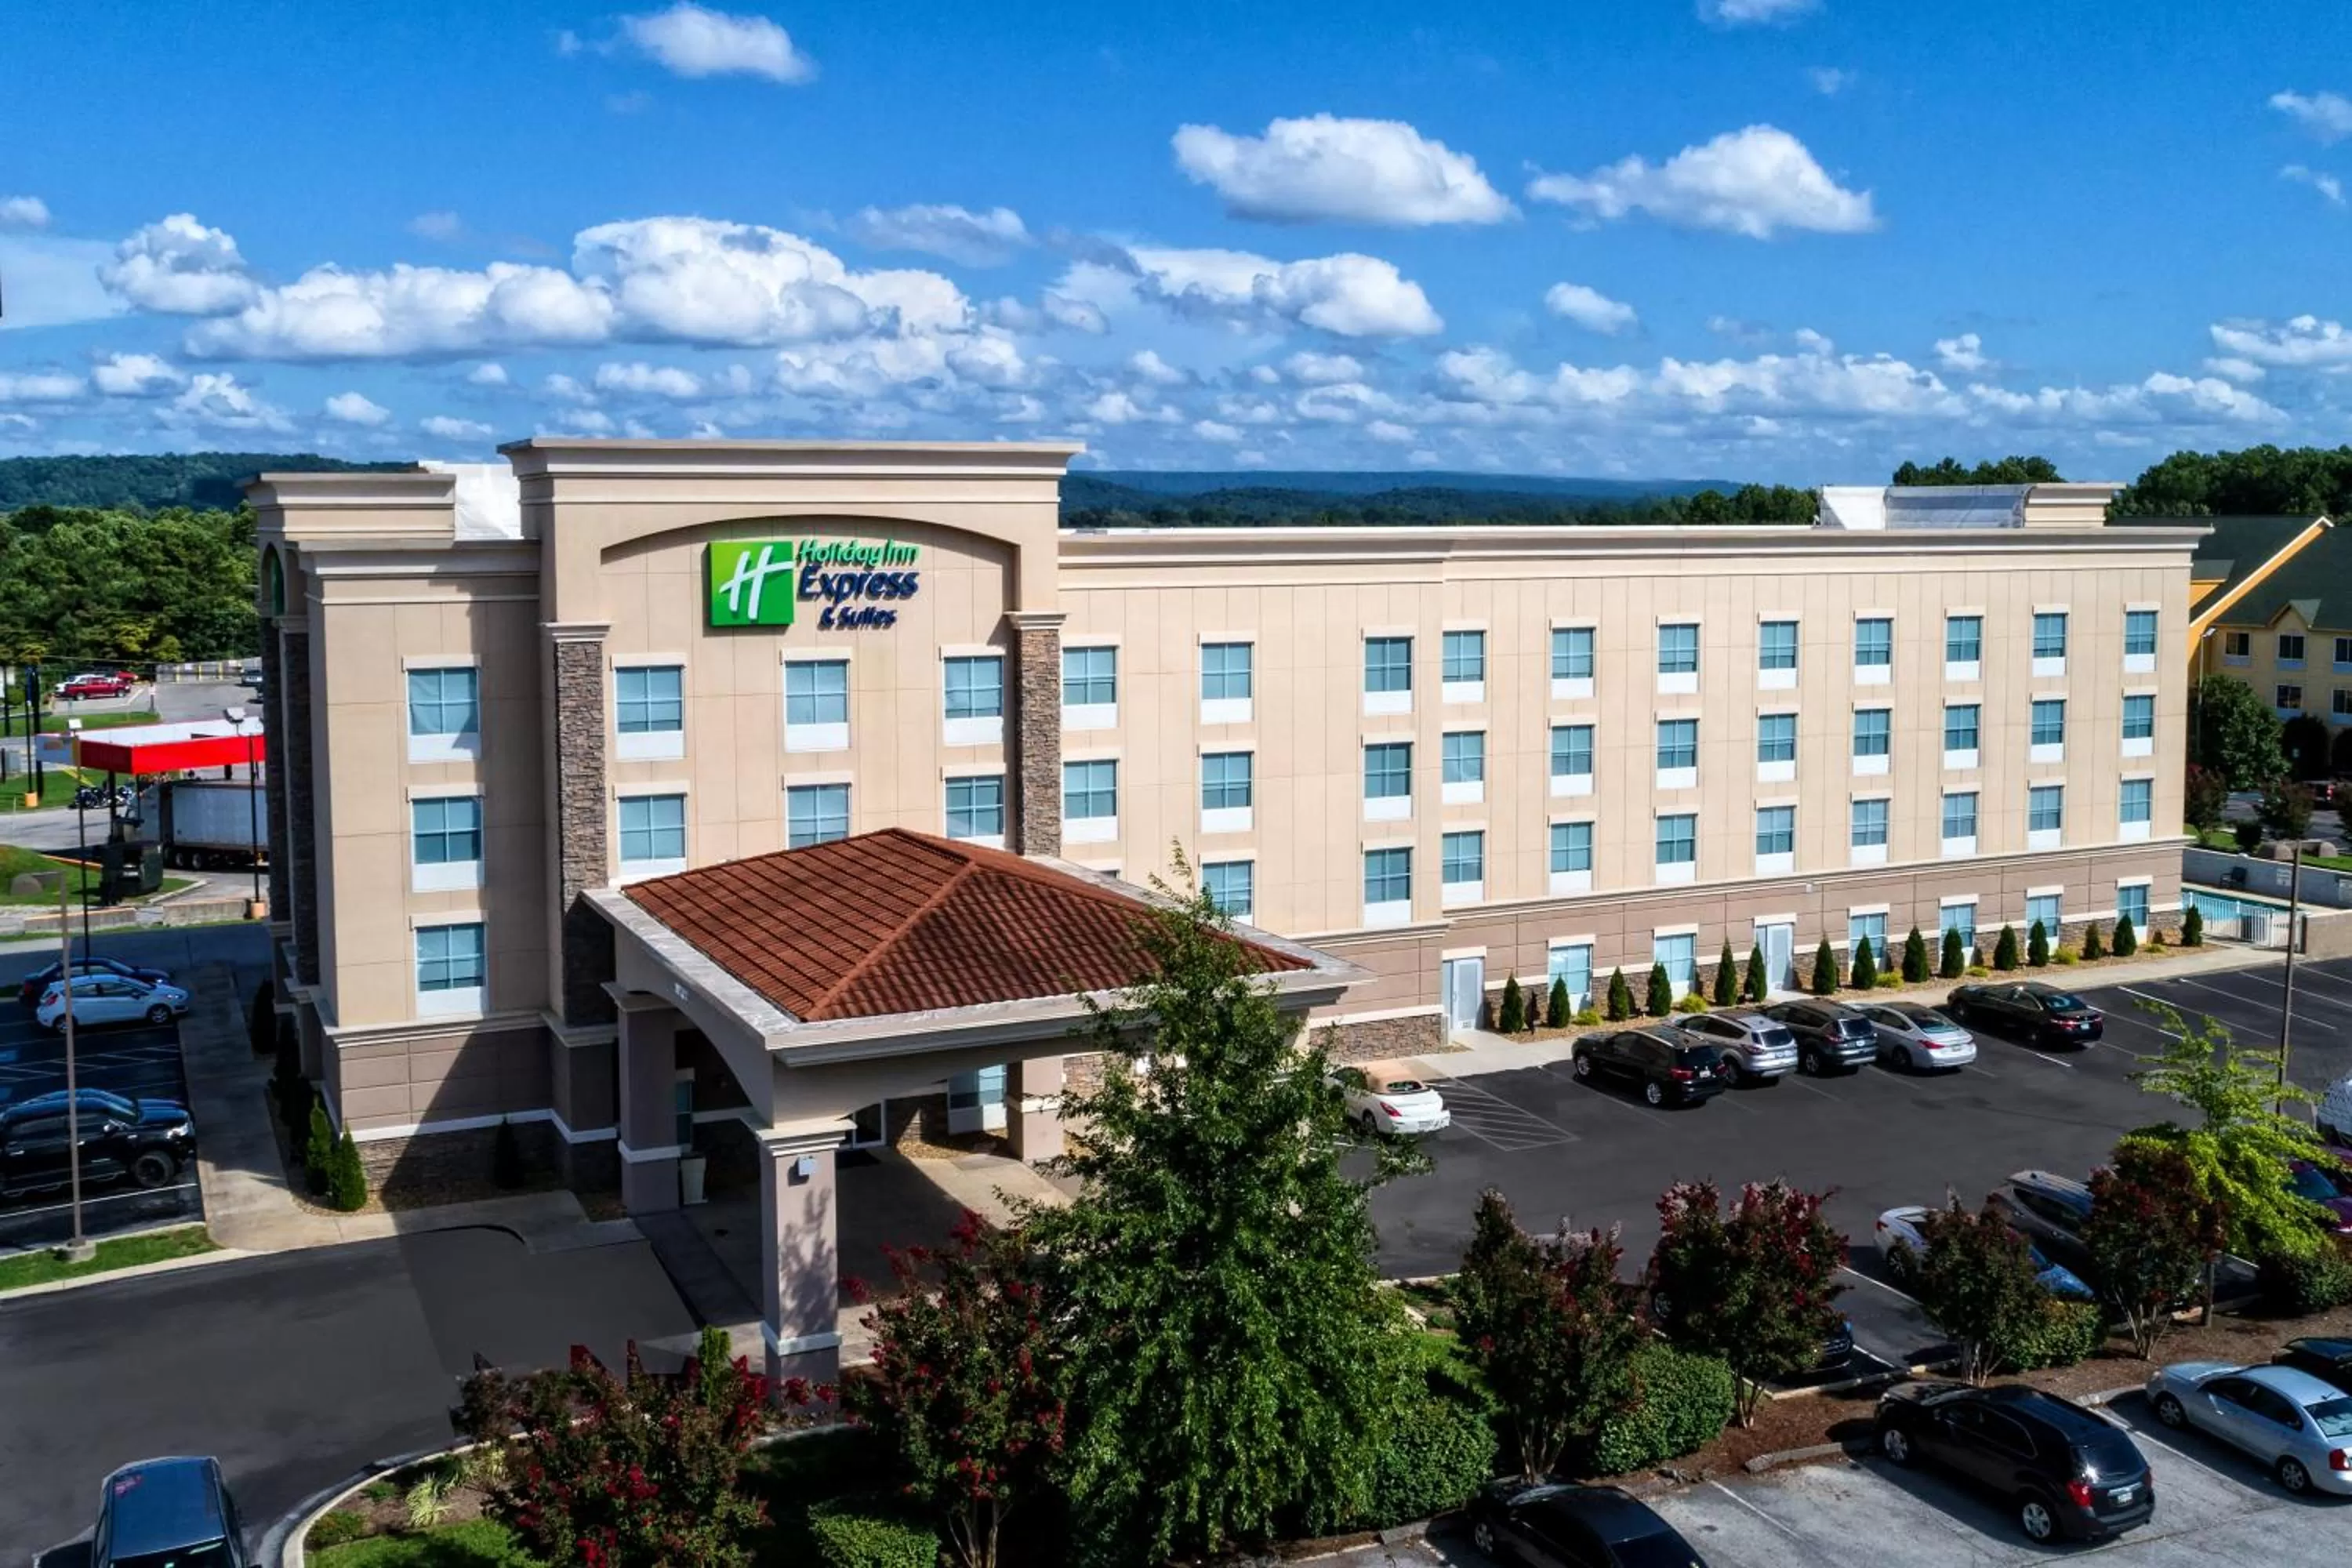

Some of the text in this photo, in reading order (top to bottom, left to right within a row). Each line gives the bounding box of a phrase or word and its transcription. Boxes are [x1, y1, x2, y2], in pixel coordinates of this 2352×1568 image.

[800, 539, 920, 564] Holiday Inn
[799, 564, 920, 603] Express
[820, 607, 898, 628] & Suites
